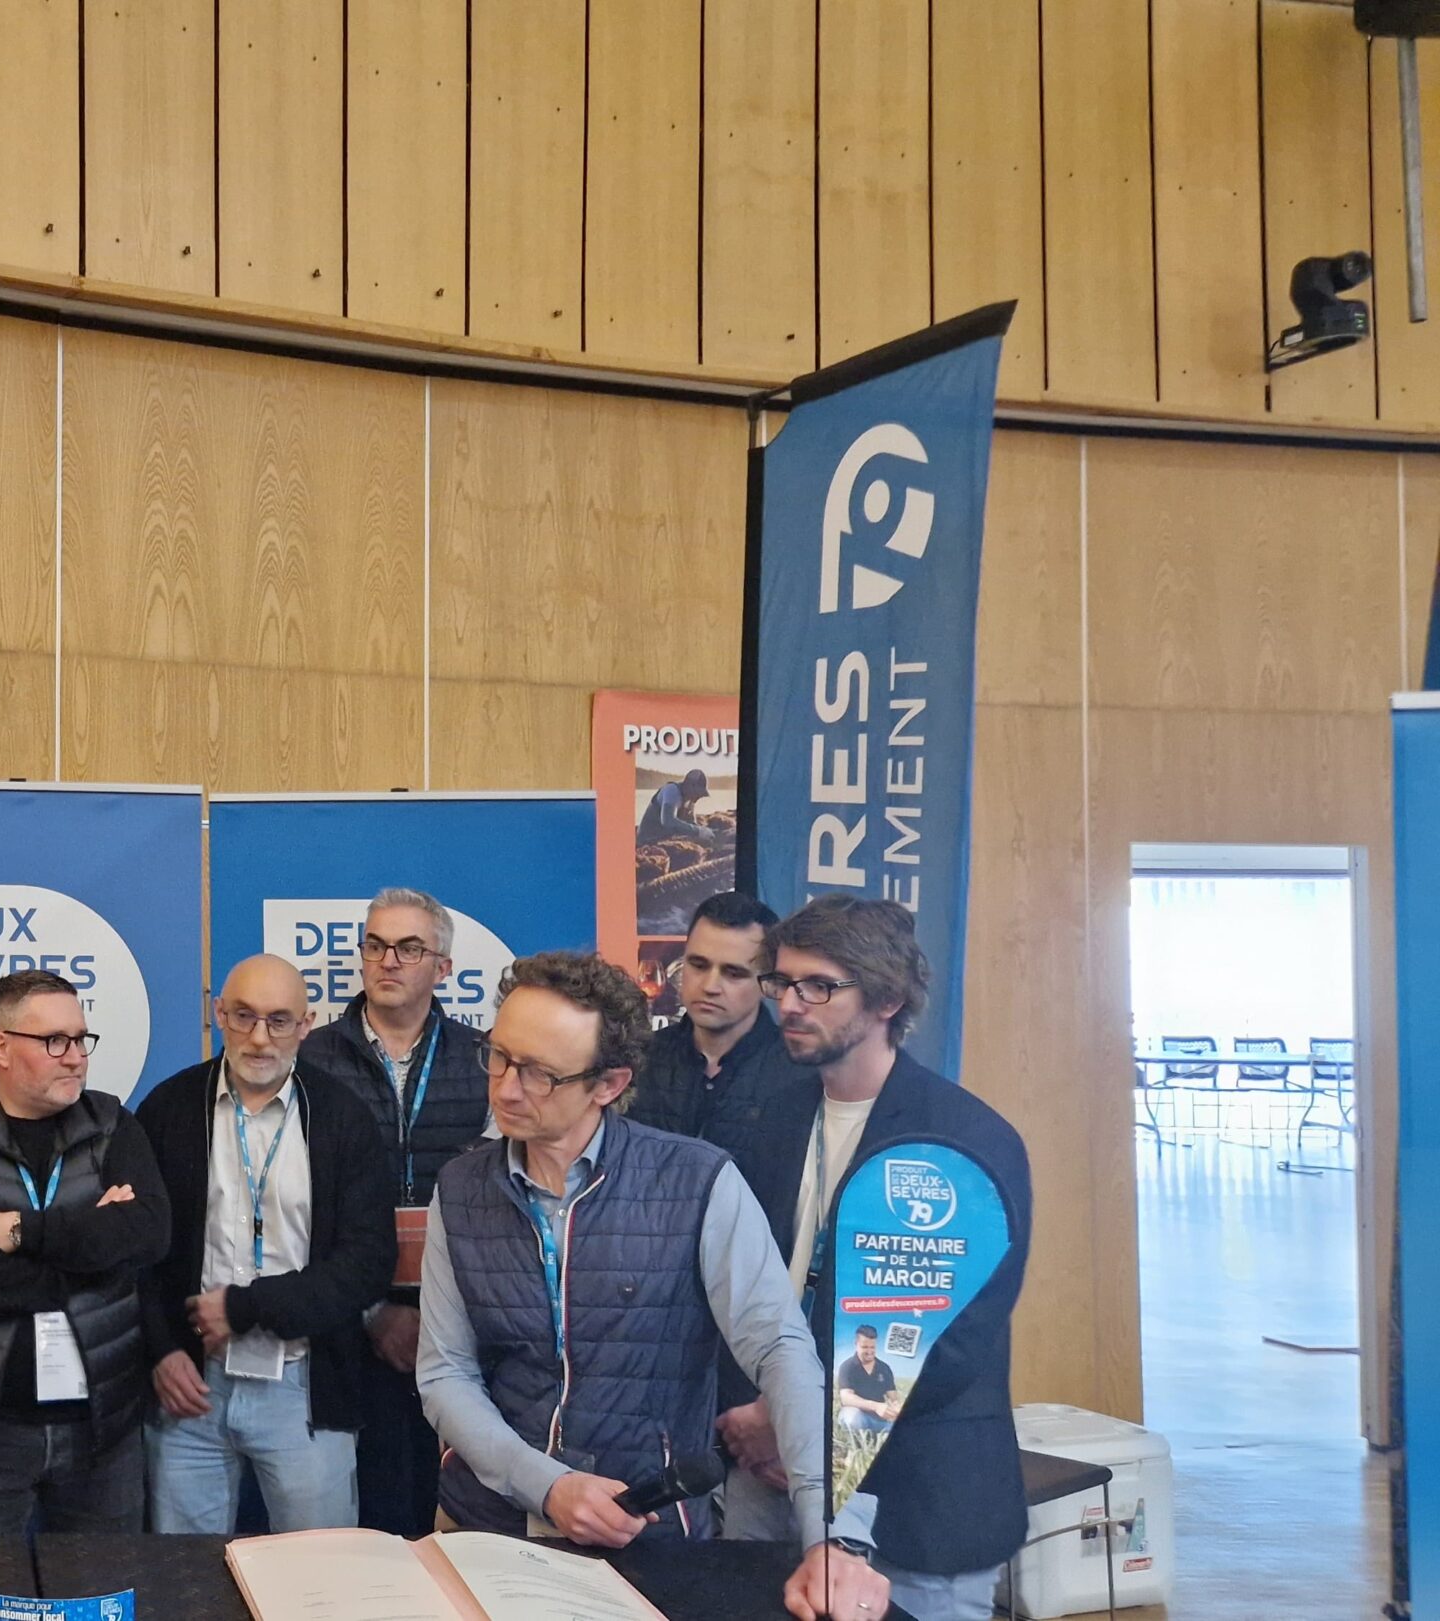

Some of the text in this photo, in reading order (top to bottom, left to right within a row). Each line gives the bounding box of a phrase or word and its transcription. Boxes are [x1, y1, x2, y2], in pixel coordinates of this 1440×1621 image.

[807, 649, 870, 904] RES
[907, 1200, 934, 1224] 79
[854, 1233, 966, 1255] PARTENAIRE
[889, 1254, 930, 1268] DE LA
[865, 1267, 954, 1290] MARQUE
[1, 1597, 52, 1612] La marque pour
[42, 1610, 65, 1621] local
